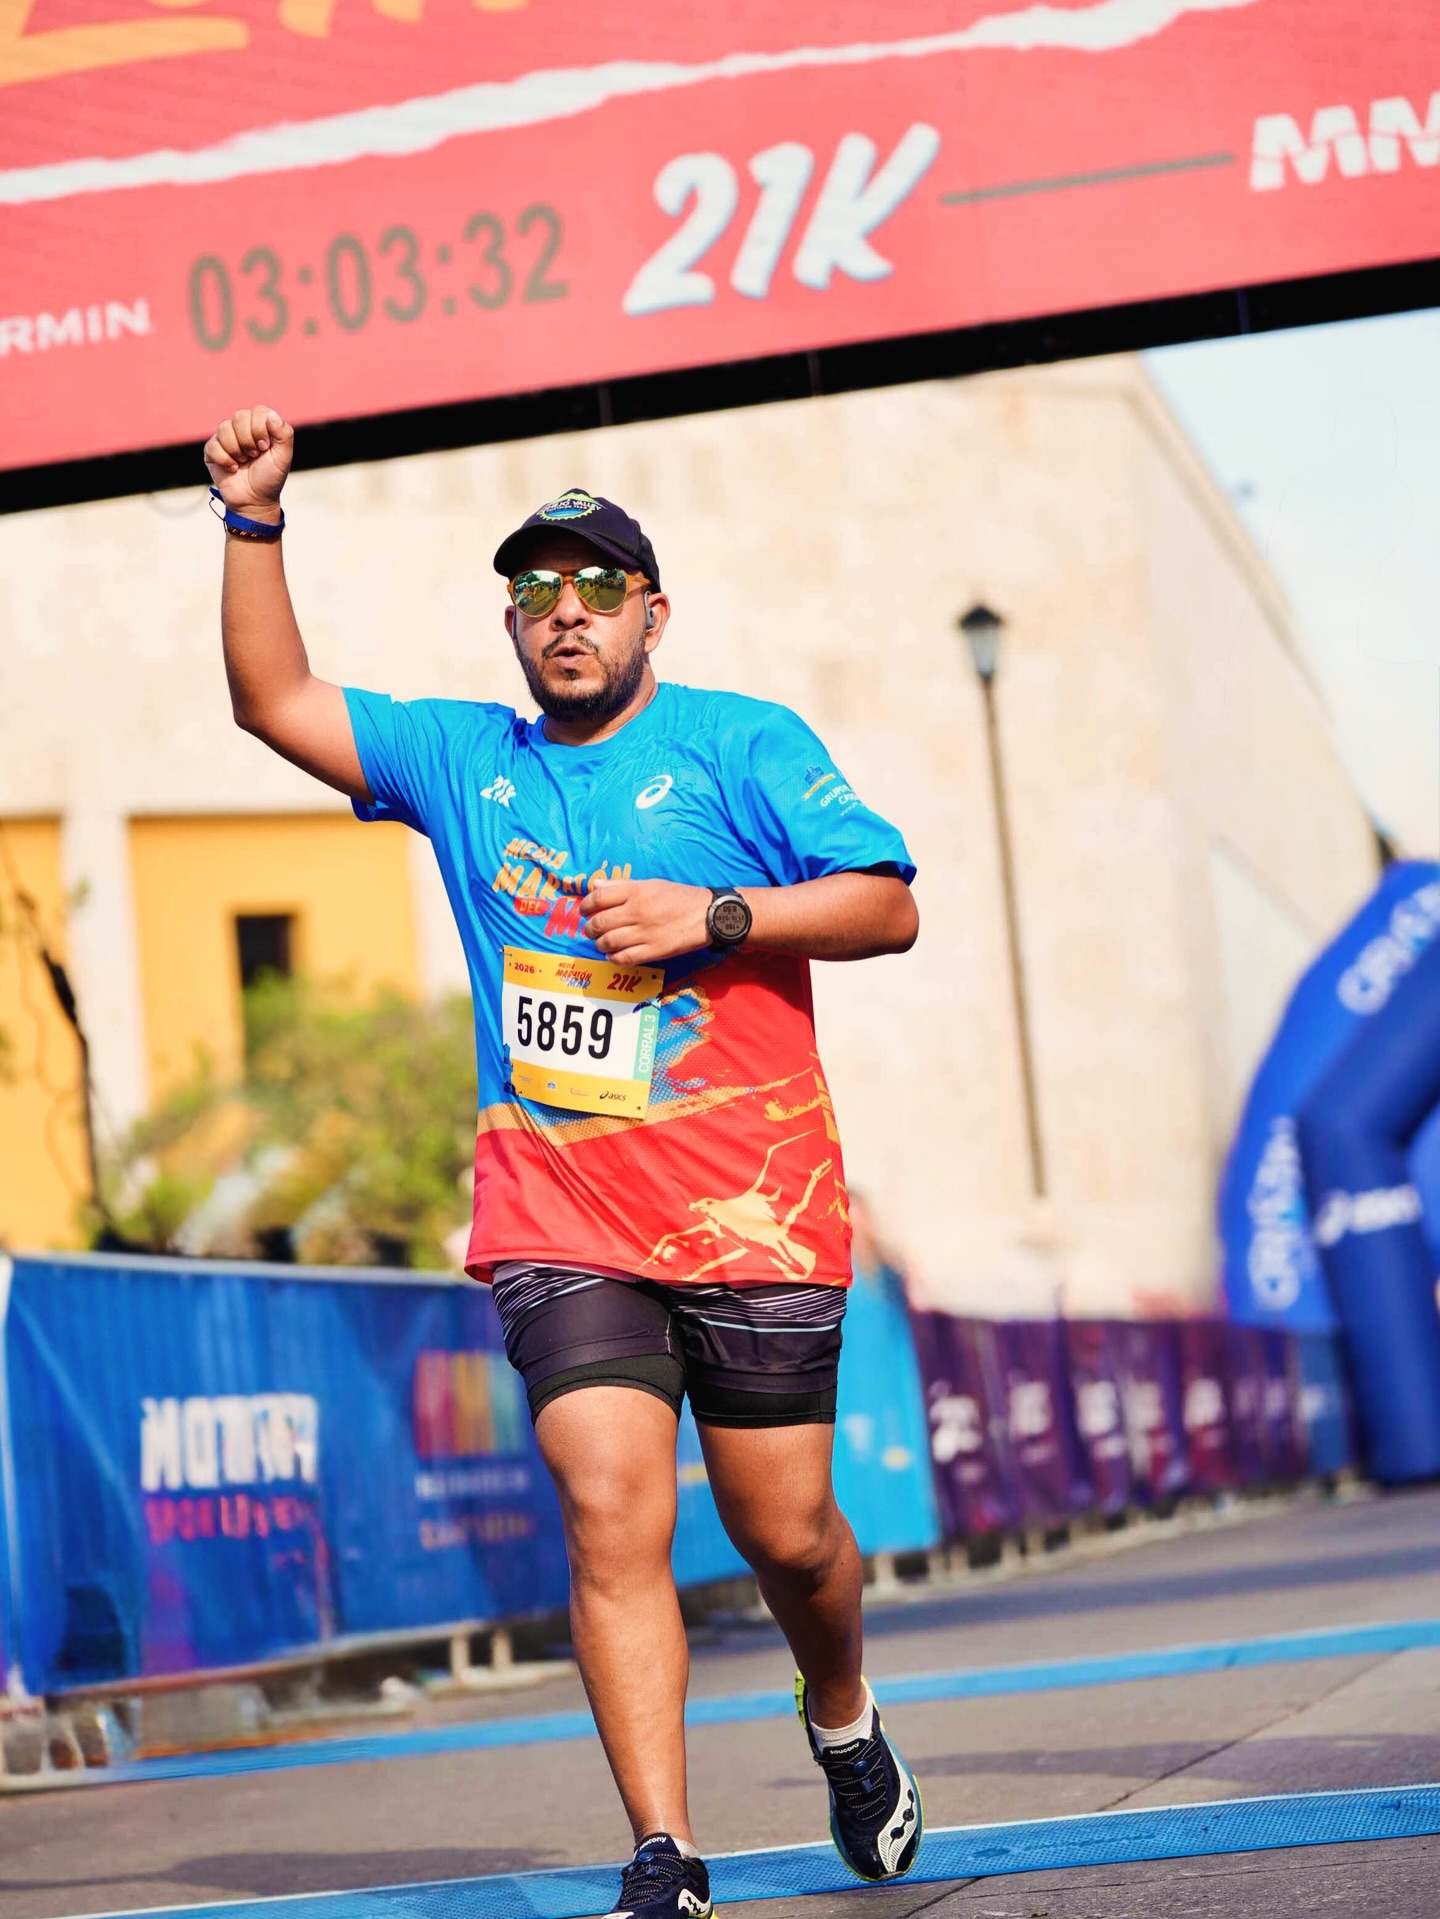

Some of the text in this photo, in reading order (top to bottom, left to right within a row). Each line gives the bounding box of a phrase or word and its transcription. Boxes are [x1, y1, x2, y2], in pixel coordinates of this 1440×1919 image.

[622, 122, 941, 316] 21K
[187, 204, 570, 353] 03:03:32
[0, 297, 151, 357] RMIN
[503, 837, 568, 870] MEDIA
[519, 900, 541, 914] DEL
[514, 962, 535, 974] 2026
[607, 973, 642, 993] 21K
[517, 995, 613, 1060] 5859
[638, 1014, 656, 1073] CORRAL 3
[608, 1092, 626, 1101] asics
[830, 1742, 859, 1754] saucony
